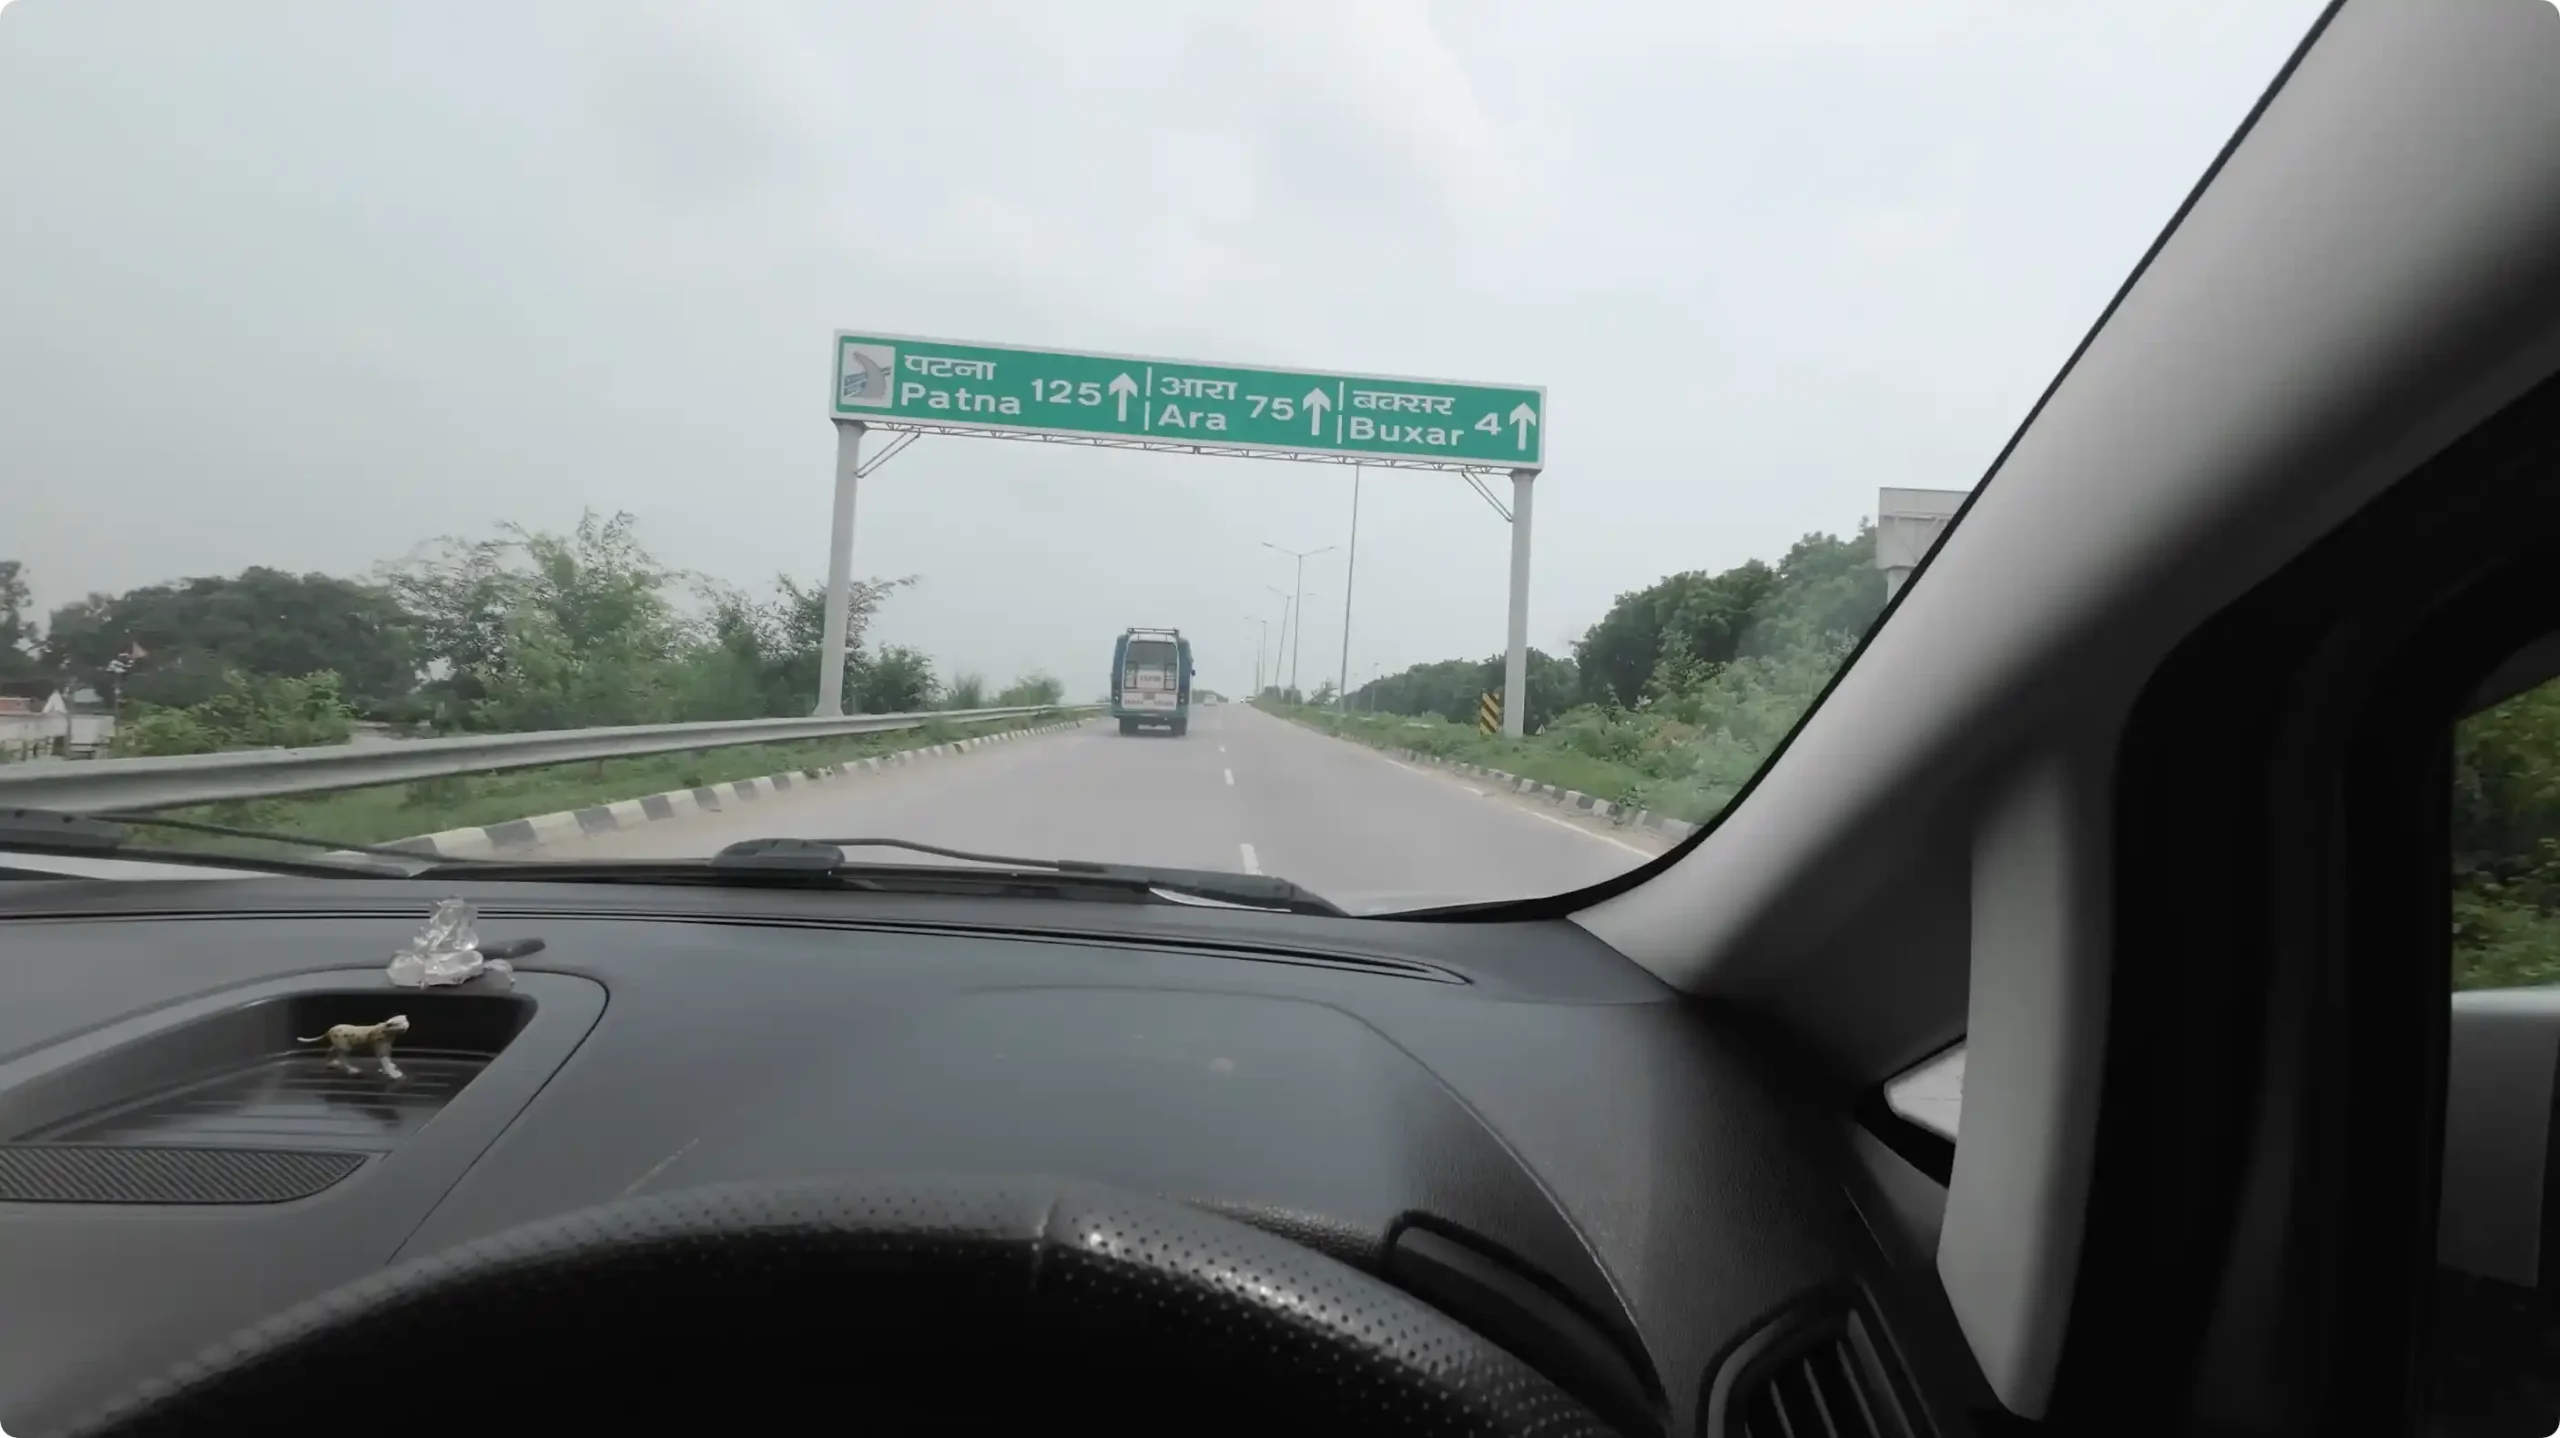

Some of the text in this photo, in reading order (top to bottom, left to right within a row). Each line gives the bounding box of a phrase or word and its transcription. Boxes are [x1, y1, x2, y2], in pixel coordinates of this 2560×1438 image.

[904, 354, 997, 380] पटना
[901, 383, 1021, 415] Patna
[1032, 378, 1102, 406] 125
[1160, 377, 1238, 400] आरा
[1246, 395, 1294, 421] 75
[1353, 390, 1455, 415] बक्सर
[1158, 404, 1227, 431] Ara
[1475, 412, 1502, 435] 4
[1350, 417, 1464, 446] Buxar
